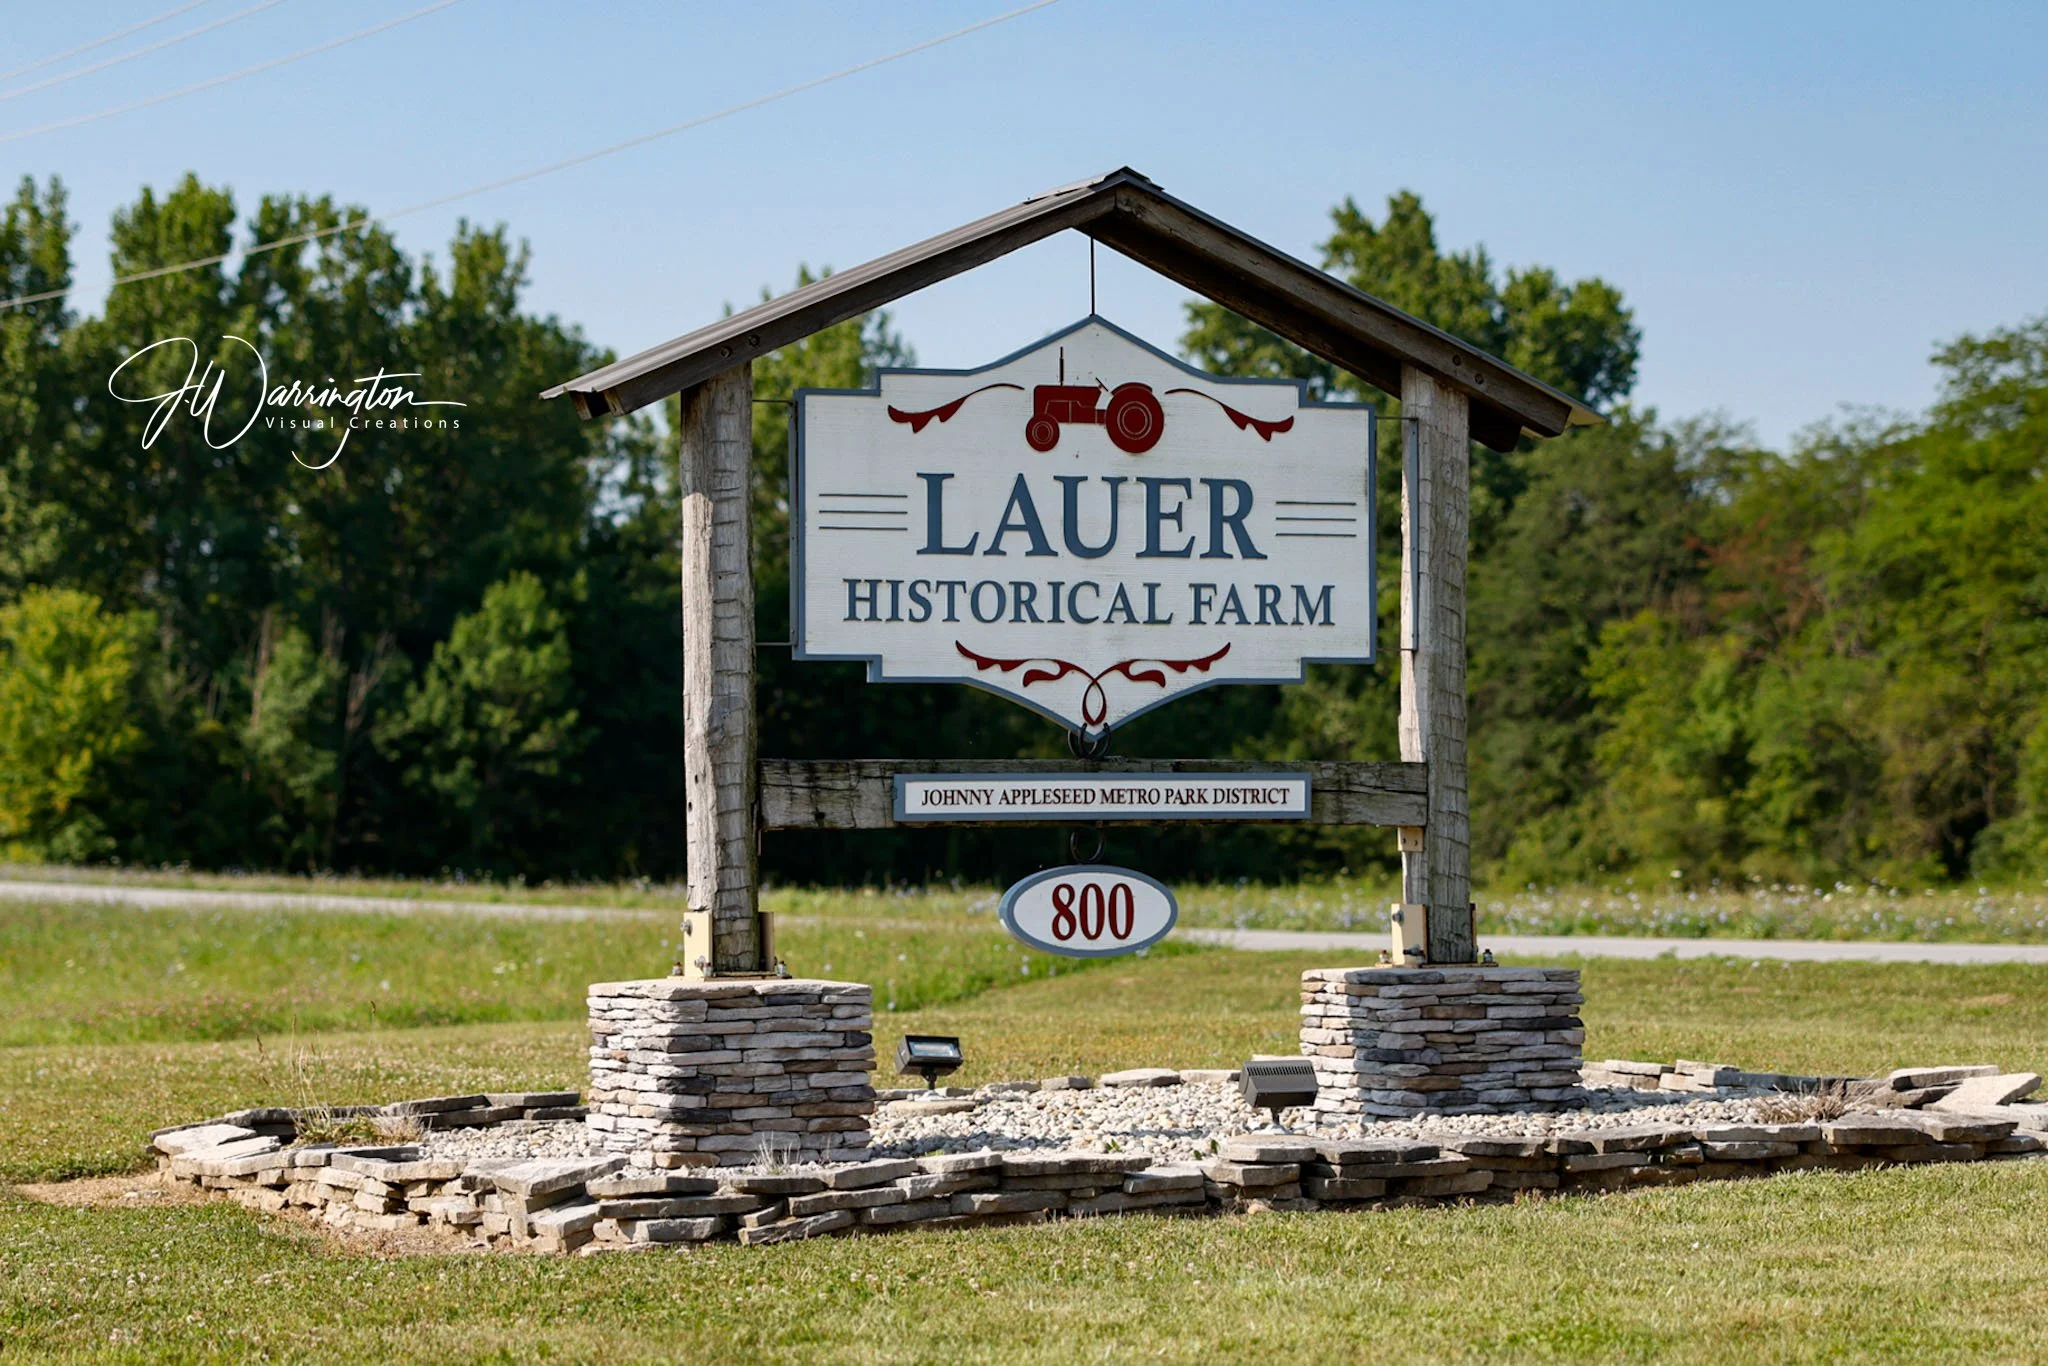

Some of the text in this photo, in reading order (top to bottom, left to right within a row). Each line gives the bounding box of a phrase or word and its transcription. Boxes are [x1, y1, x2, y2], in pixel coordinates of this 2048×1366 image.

[916, 472, 1267, 559] LAUER
[843, 578, 1335, 626] HISTORICAL FARM
[922, 787, 1290, 806] JOHNNY APPLESEED METRO PARK DISTRICT
[1051, 883, 1134, 941] 800
